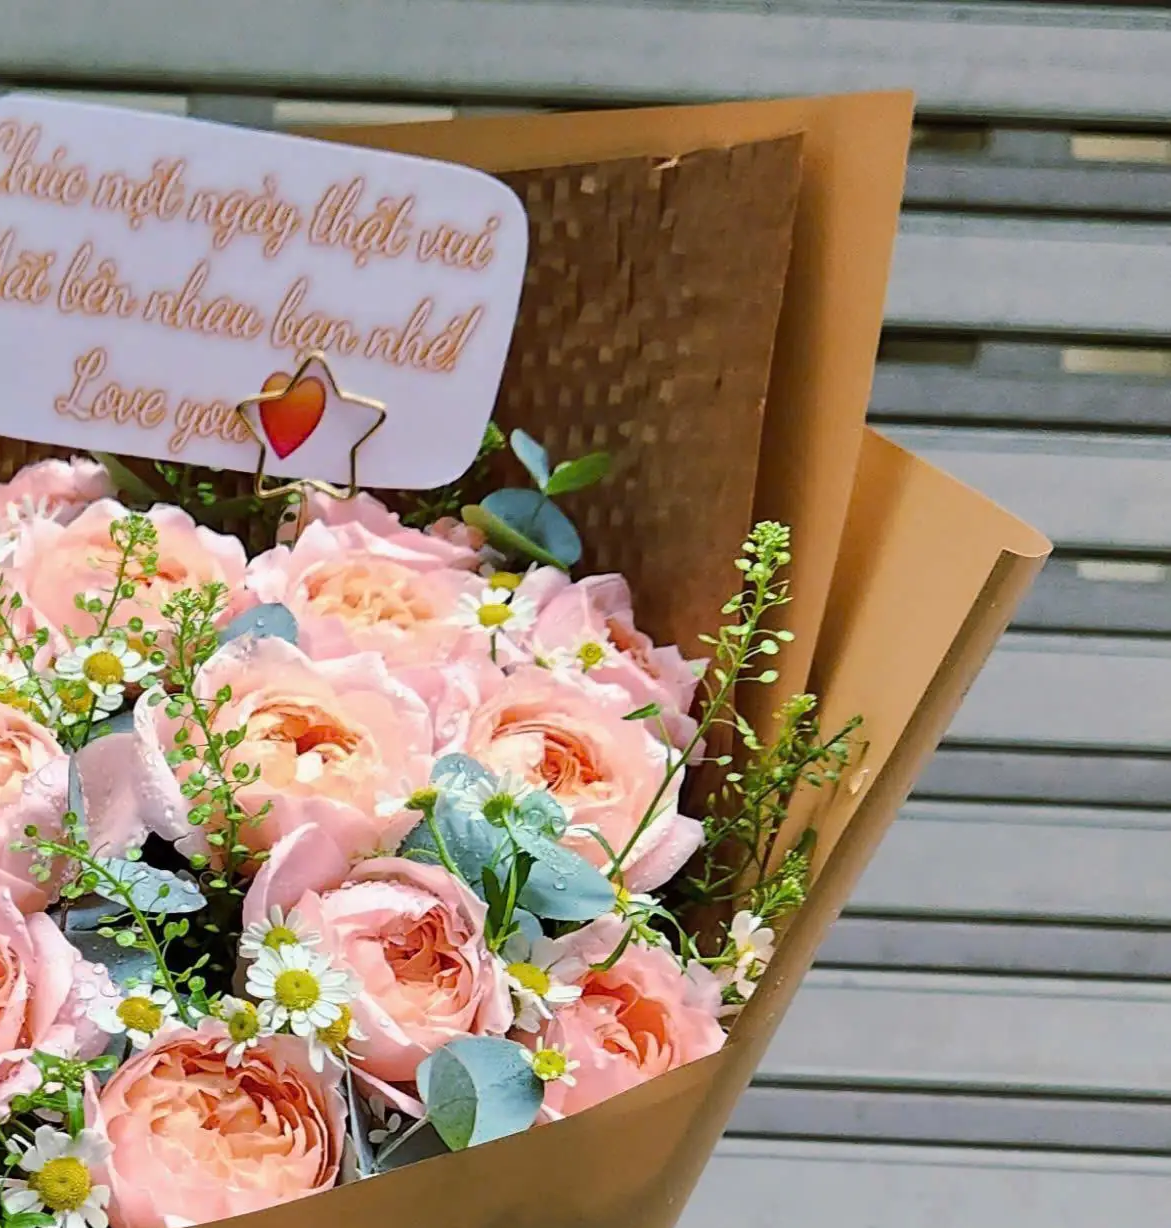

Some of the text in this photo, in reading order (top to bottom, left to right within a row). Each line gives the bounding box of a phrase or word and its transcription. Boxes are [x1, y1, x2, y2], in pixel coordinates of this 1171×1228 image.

[92, 157, 185, 230] một
[187, 174, 301, 259] ngày
[308, 176, 416, 268] thật
[416, 214, 502, 270] vui
[57, 240, 137, 317] bên
[142, 258, 265, 340] nhau
[269, 276, 359, 364] bạn
[364, 296, 485, 374] nhé!
[54, 346, 255, 453] Love you
